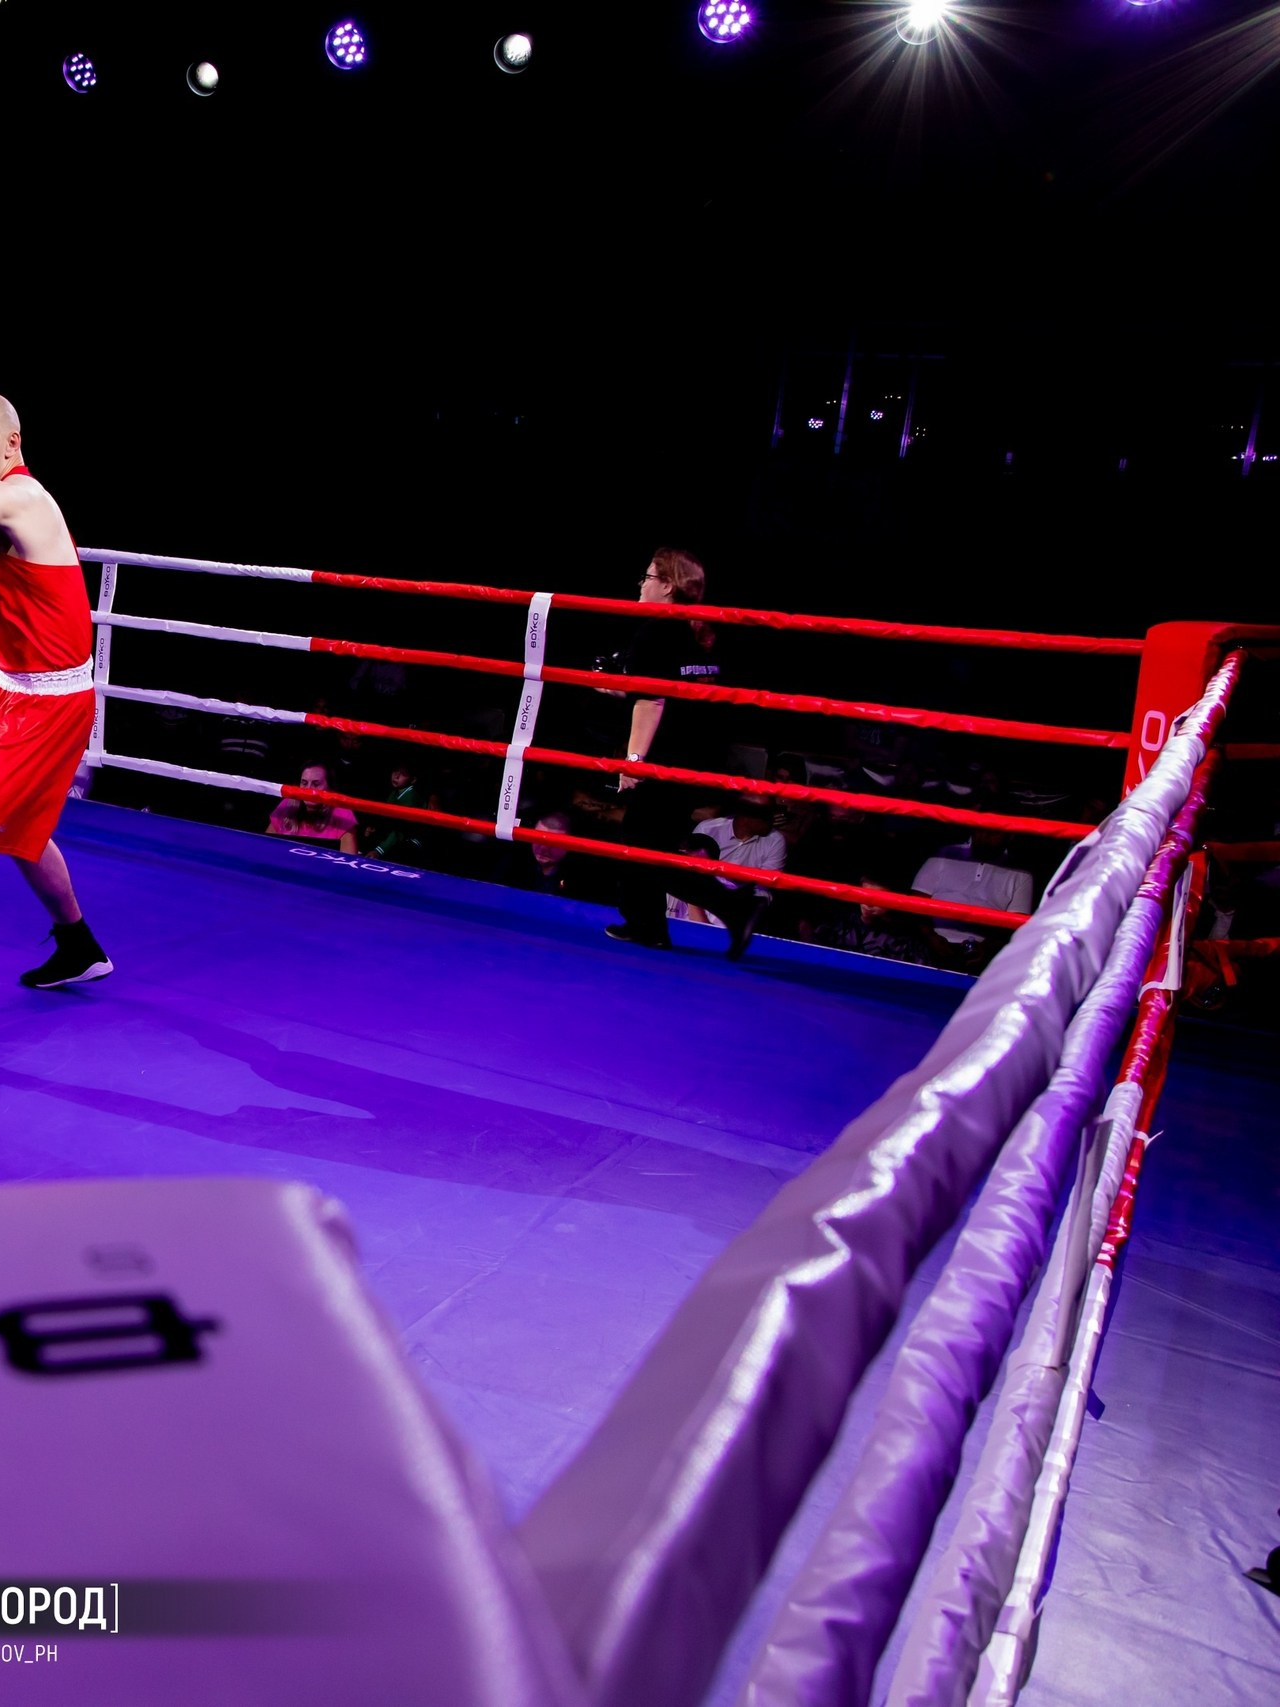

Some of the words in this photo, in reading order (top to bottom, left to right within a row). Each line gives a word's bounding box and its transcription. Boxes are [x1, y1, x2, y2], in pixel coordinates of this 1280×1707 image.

[530, 612, 539, 649] BOYKO
[520, 695, 532, 730] BOYKO
[504, 775, 513, 811] BOYKO
